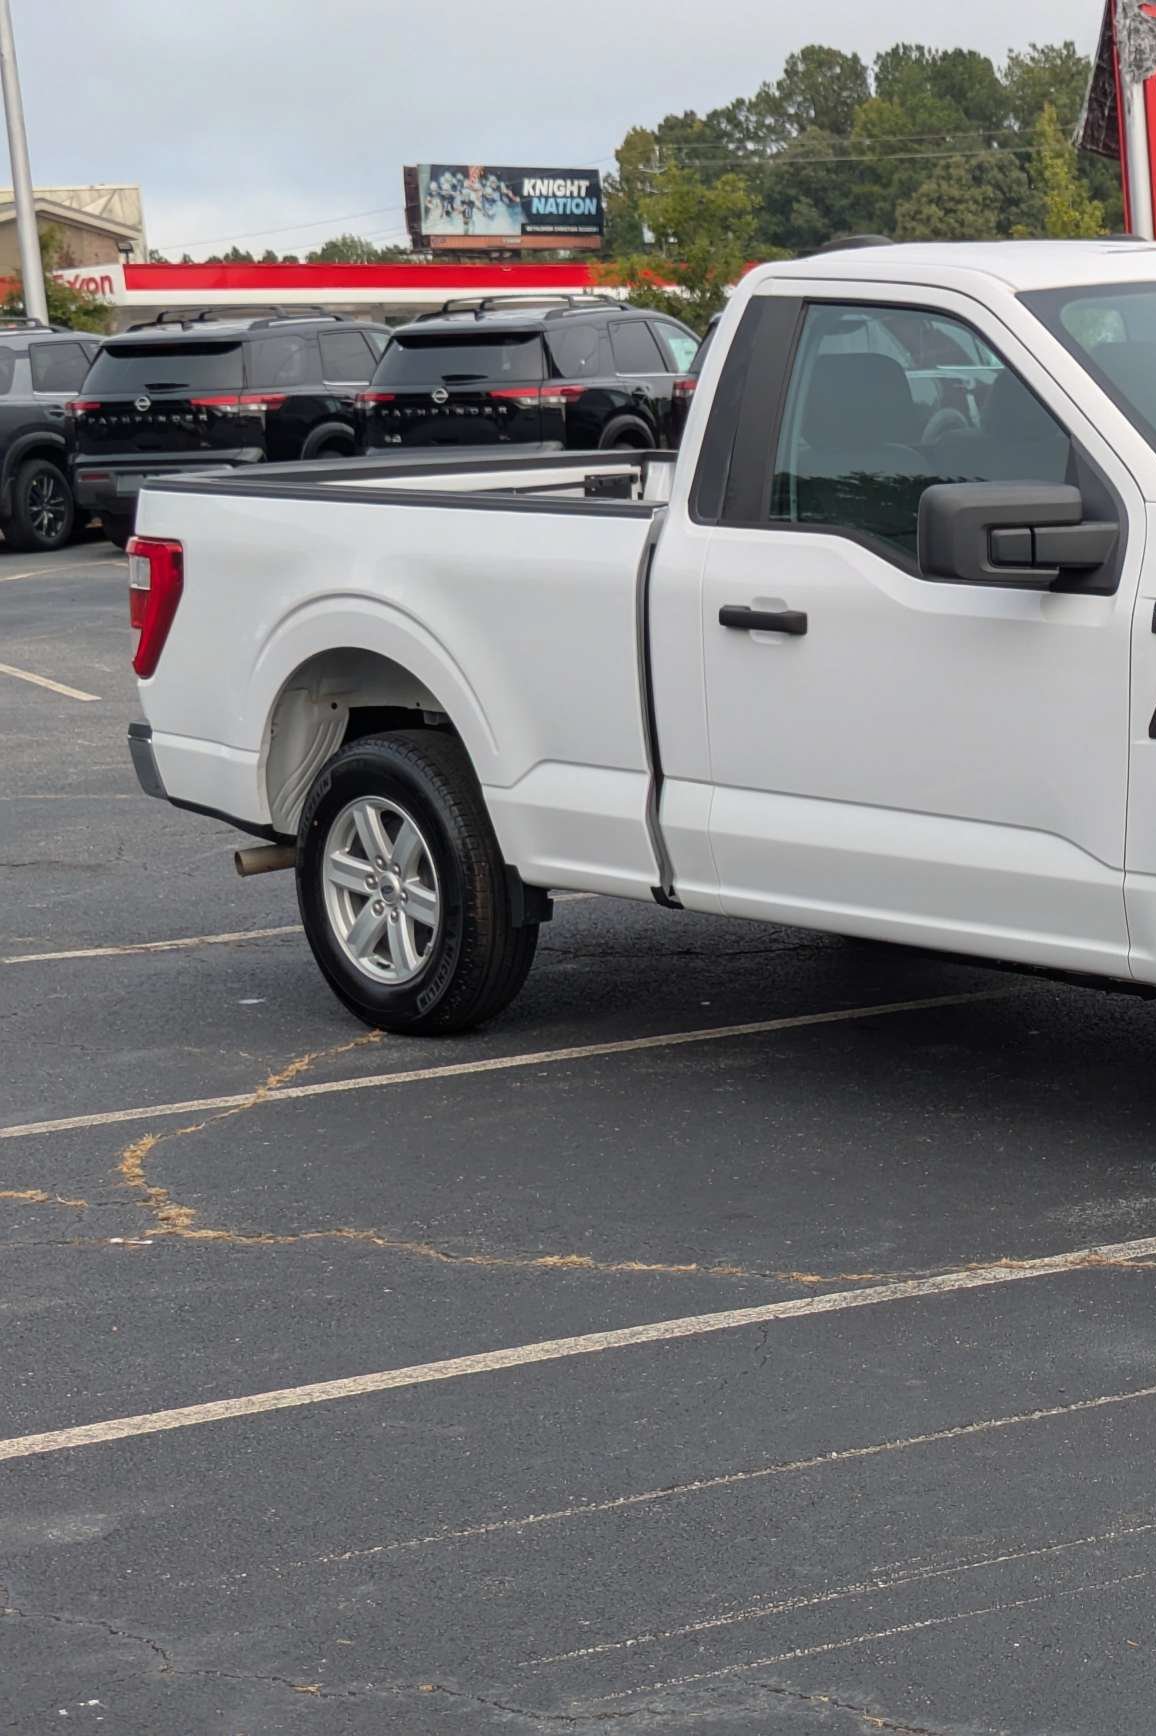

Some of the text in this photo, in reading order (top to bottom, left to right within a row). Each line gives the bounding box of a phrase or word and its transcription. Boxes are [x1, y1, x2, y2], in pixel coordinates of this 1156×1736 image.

[523, 177, 590, 197] KNIGHT
[531, 197, 597, 215] NATION
[87, 413, 208, 425] PATHFINDER
[380, 405, 508, 417] PATHFINDER
[417, 940, 457, 1010] MICHELIN
